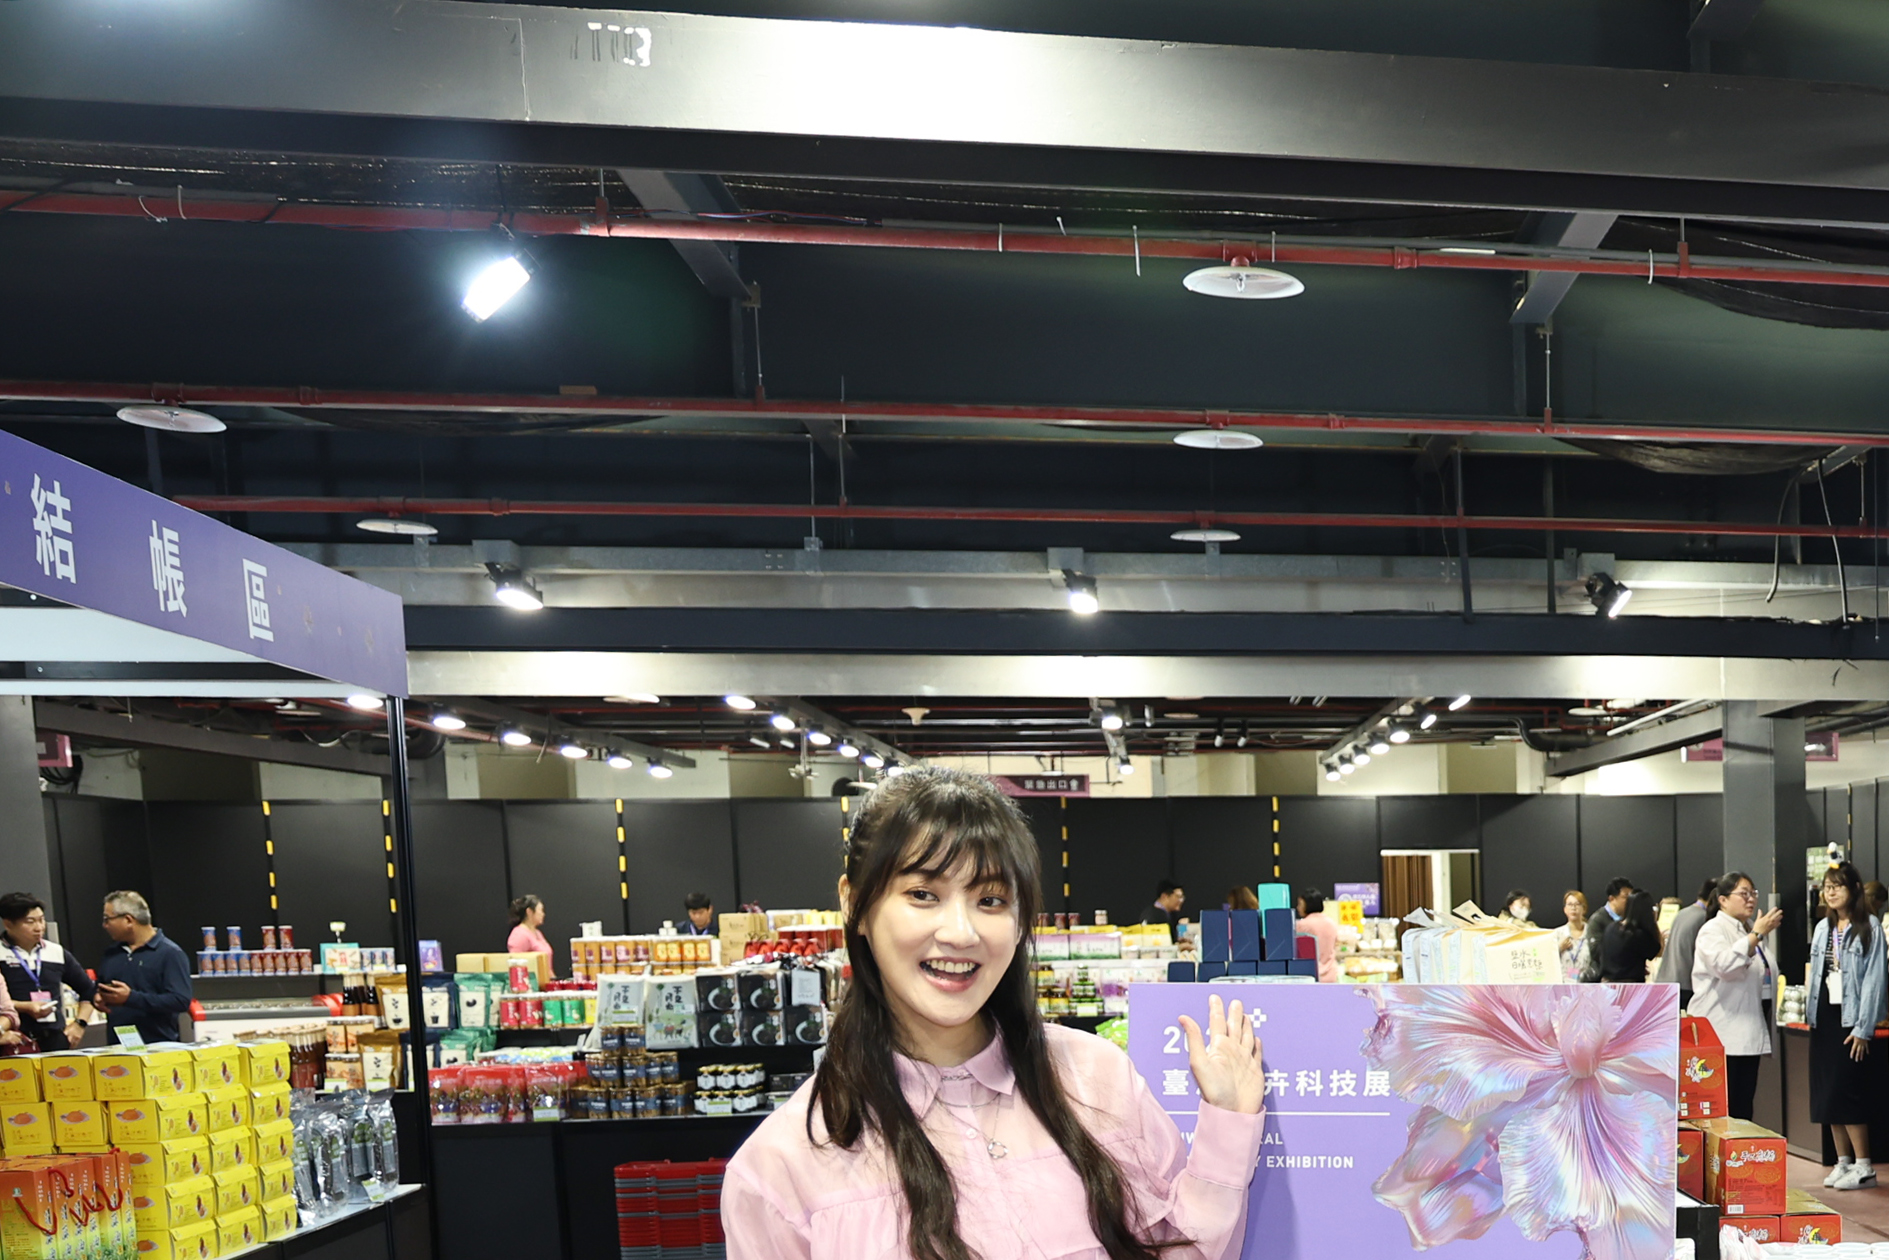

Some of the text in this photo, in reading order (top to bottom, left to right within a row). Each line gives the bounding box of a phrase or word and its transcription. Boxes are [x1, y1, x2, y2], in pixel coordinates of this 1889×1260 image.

[30, 473, 274, 642] 結帳區
[1162, 1069, 1391, 1097] 臺卉科技展
[1266, 1155, 1354, 1168] EXHIBITION
